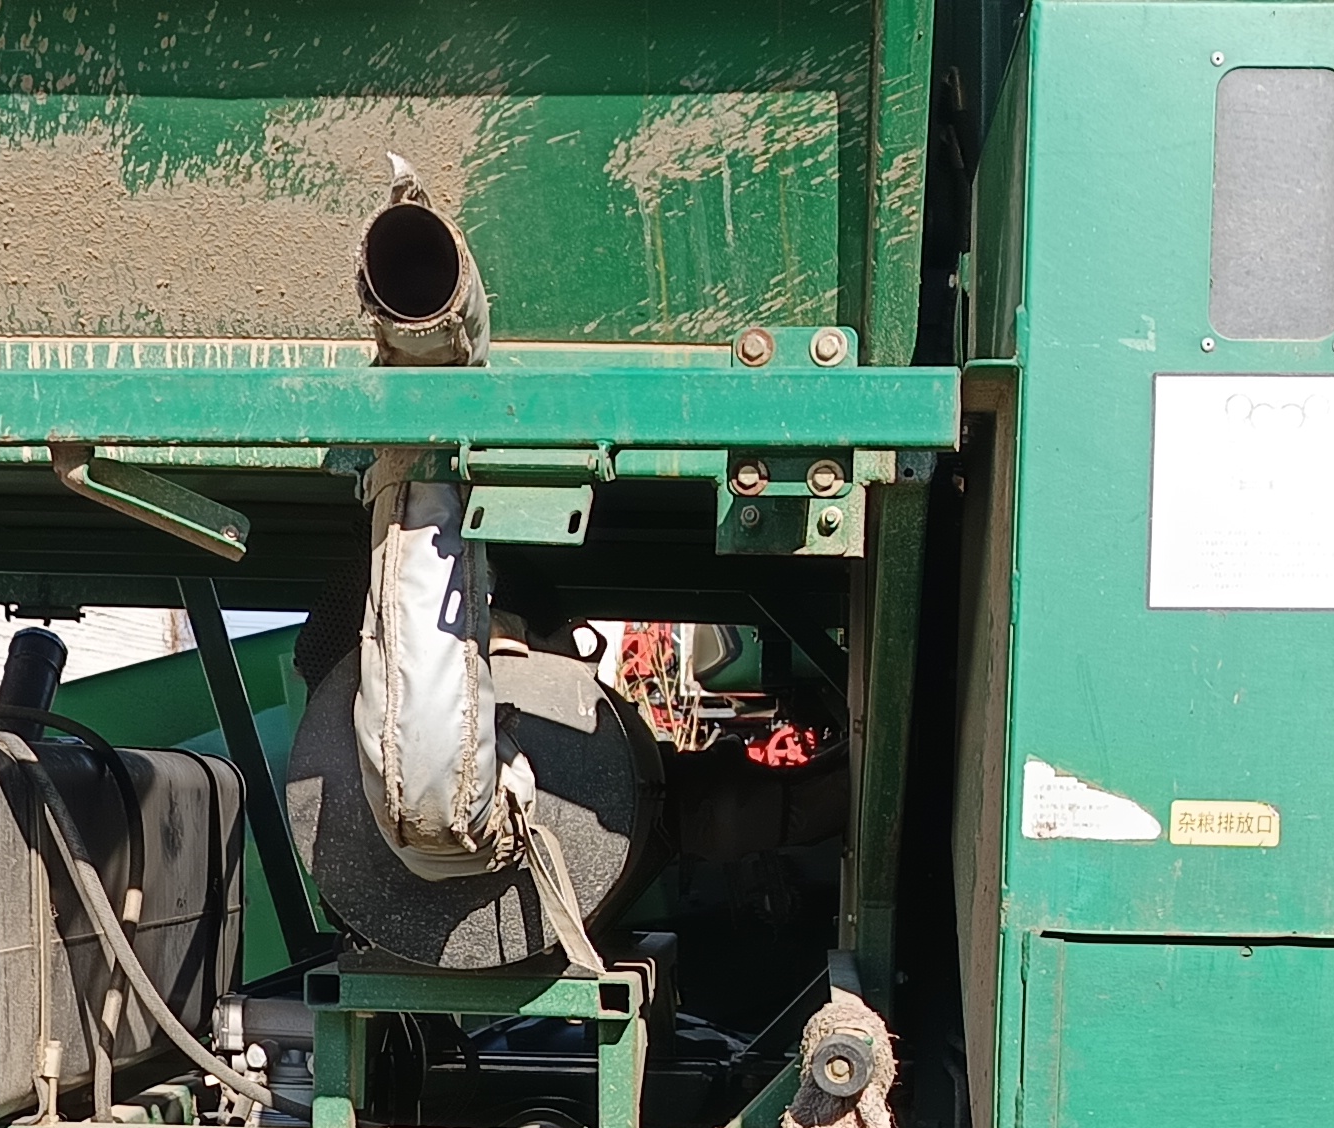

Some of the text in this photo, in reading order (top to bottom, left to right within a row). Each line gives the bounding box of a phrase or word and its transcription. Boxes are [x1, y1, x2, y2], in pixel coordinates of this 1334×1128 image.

[1178, 811, 1272, 834] 杂粮排放口
